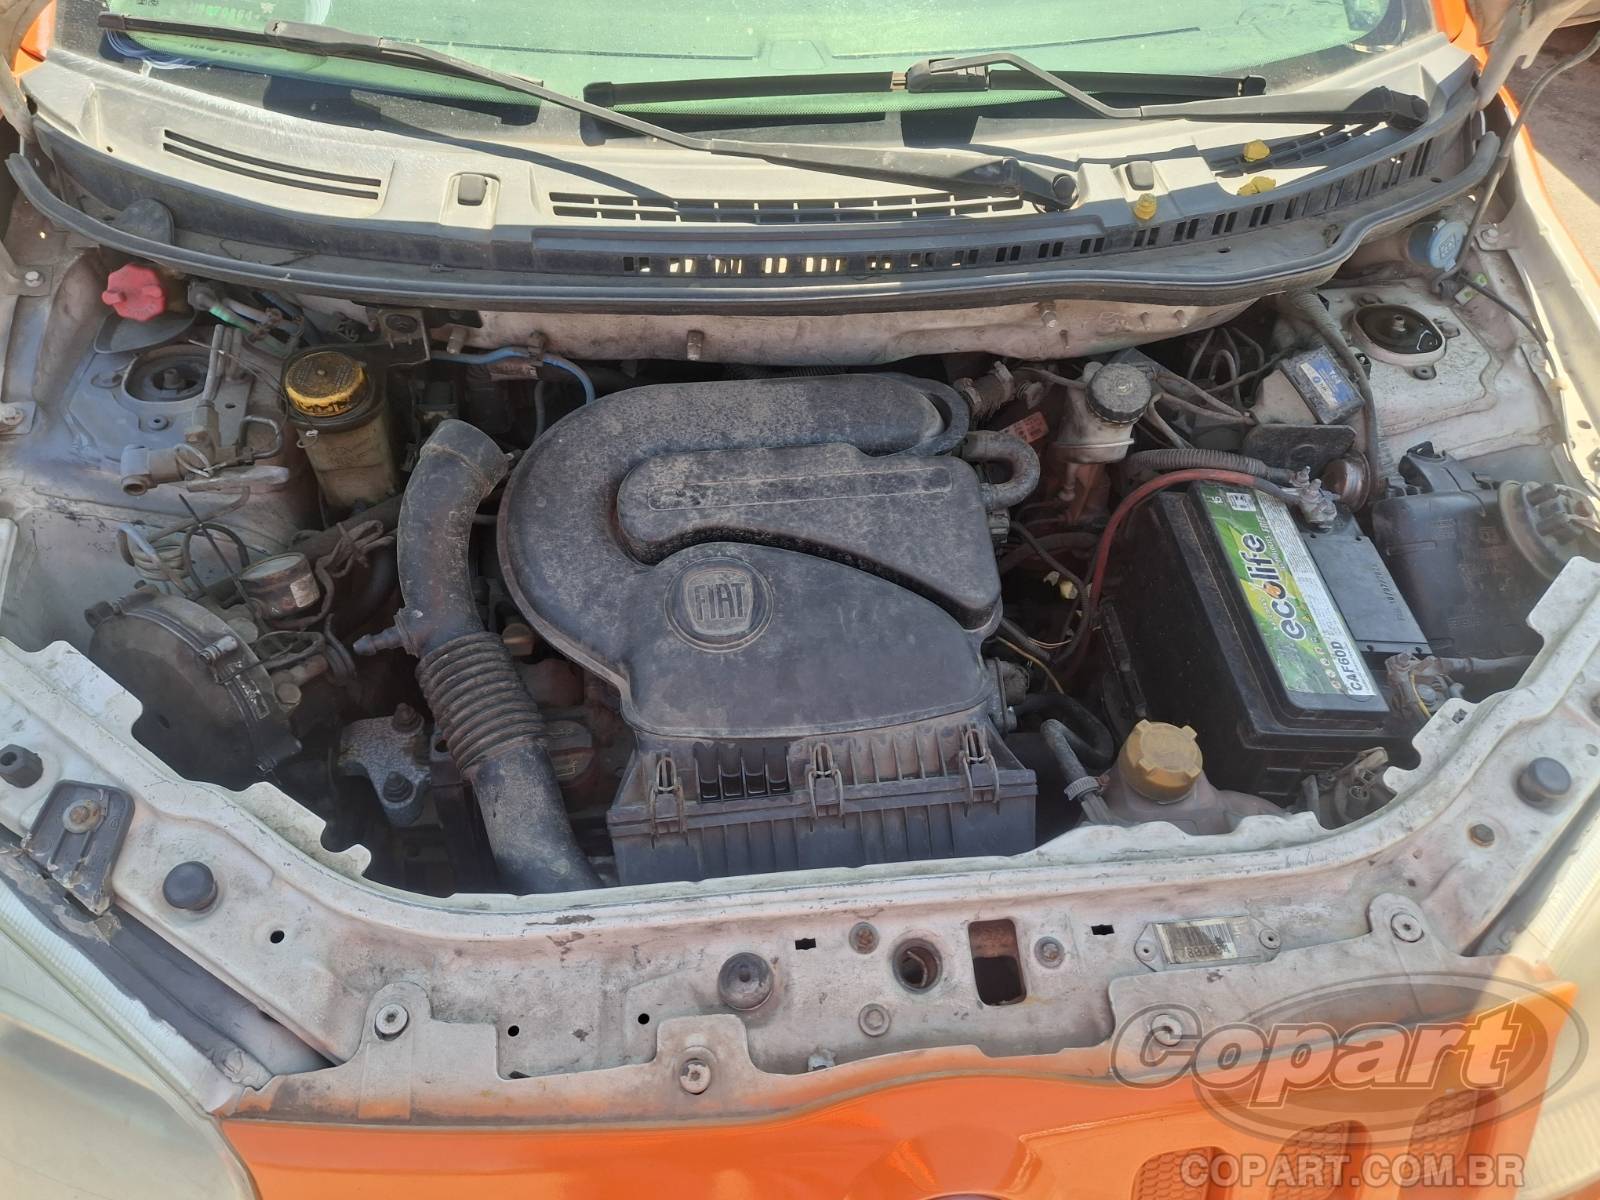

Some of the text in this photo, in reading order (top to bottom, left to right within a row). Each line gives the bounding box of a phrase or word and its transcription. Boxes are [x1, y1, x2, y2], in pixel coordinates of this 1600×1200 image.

[694, 582, 746, 621] FIAT
[1240, 533, 1306, 641] ecolife
[1330, 641, 1363, 692] CAF60D
